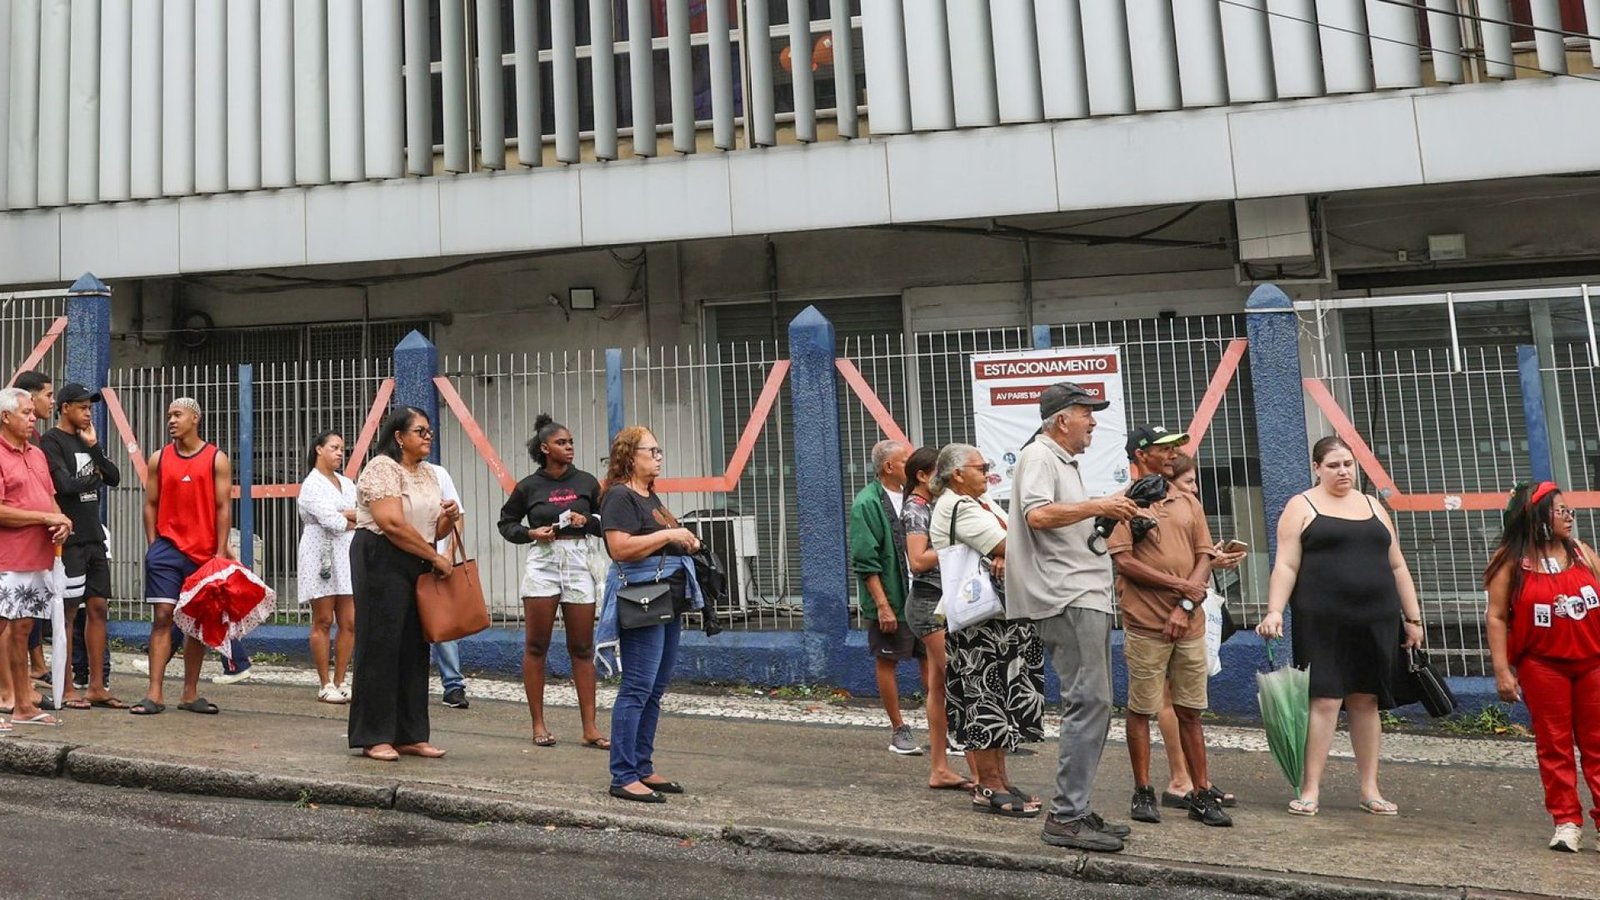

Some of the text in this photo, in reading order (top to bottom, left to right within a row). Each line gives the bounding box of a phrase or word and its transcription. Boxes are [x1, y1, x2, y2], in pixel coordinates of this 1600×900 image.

[984, 359, 1107, 376] ESTACIONAMENTO
[1007, 391, 1029, 400] PARIS
[1587, 596, 1597, 605] 13
[1572, 602, 1584, 614] 13
[1537, 615, 1548, 623] 13
